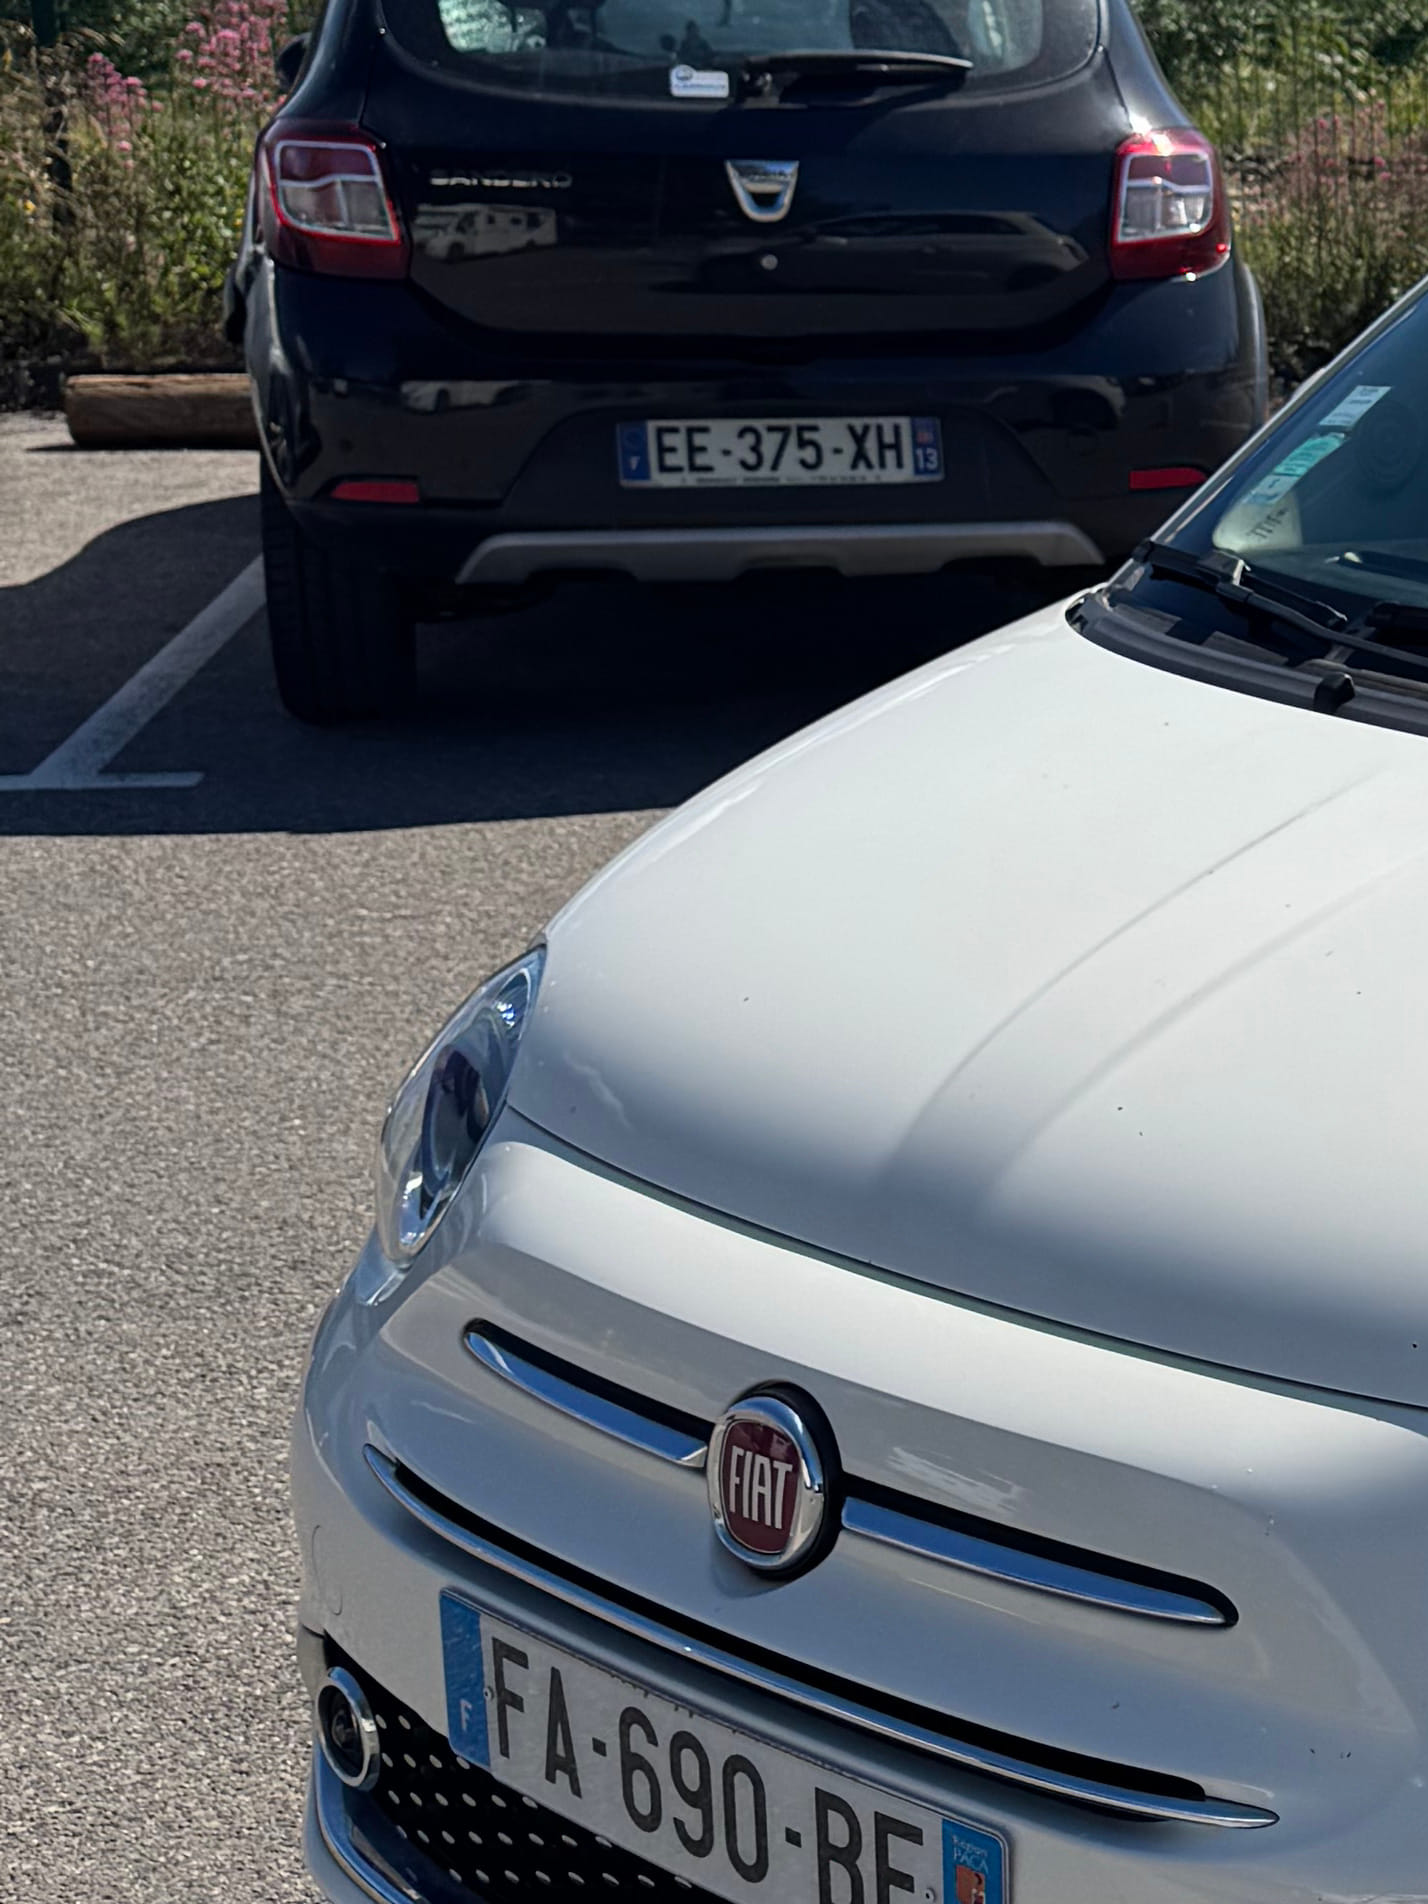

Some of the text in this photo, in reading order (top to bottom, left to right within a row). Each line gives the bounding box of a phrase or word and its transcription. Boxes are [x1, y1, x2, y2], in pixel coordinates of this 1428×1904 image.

[654, 423, 905, 474] EE-375-XH
[914, 447, 939, 470] 13
[729, 1445, 793, 1530] FIAT
[459, 1698, 473, 1733] F
[953, 1847, 989, 1875] PACA
